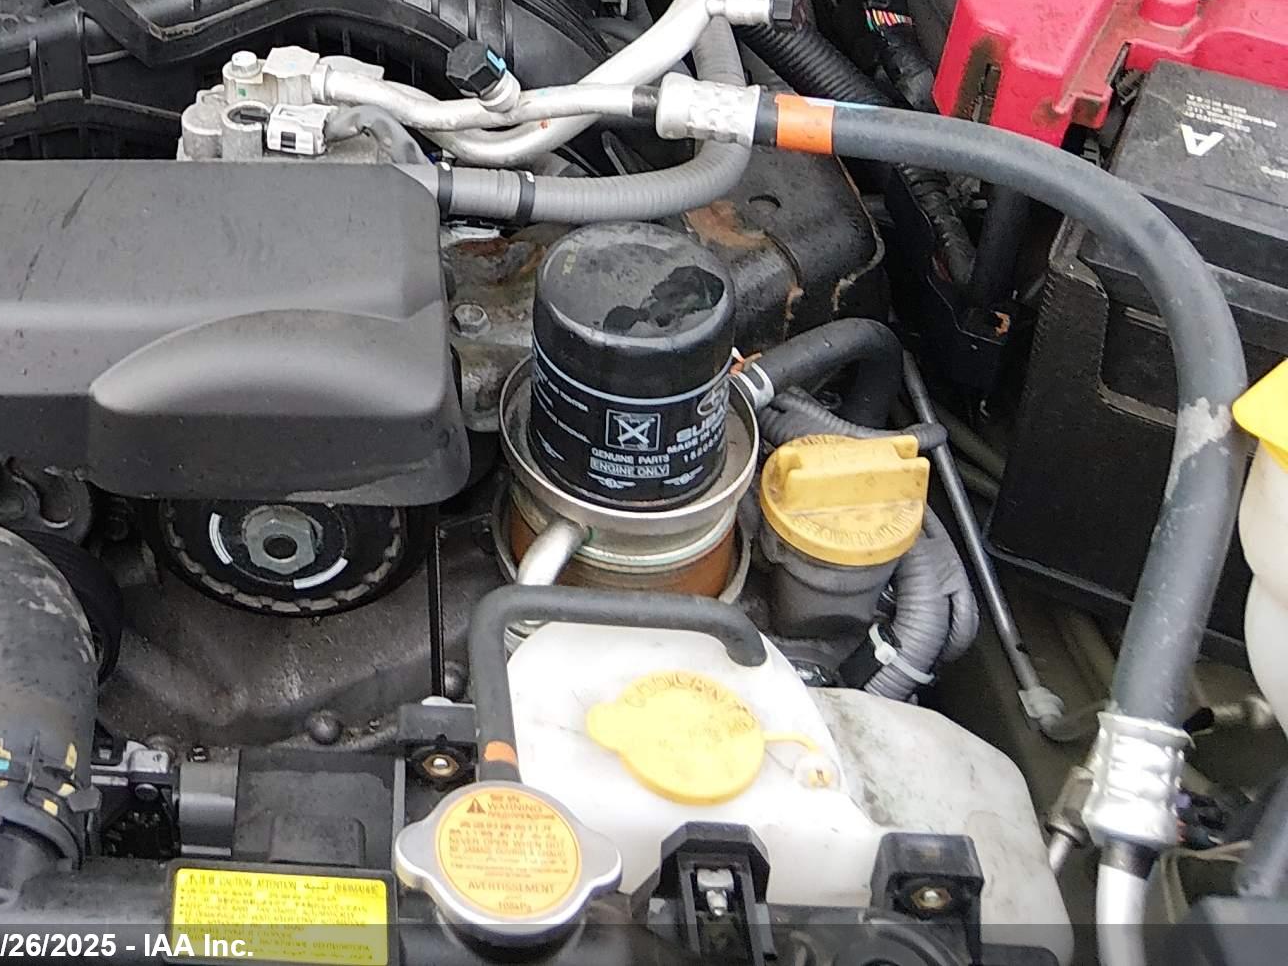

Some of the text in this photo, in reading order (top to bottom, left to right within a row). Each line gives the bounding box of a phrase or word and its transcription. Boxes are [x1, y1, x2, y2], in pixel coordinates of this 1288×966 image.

[637, 453, 670, 465] PARTS
[636, 464, 669, 476] ONLY
[468, 881, 555, 894] AVERTISSEMENT
